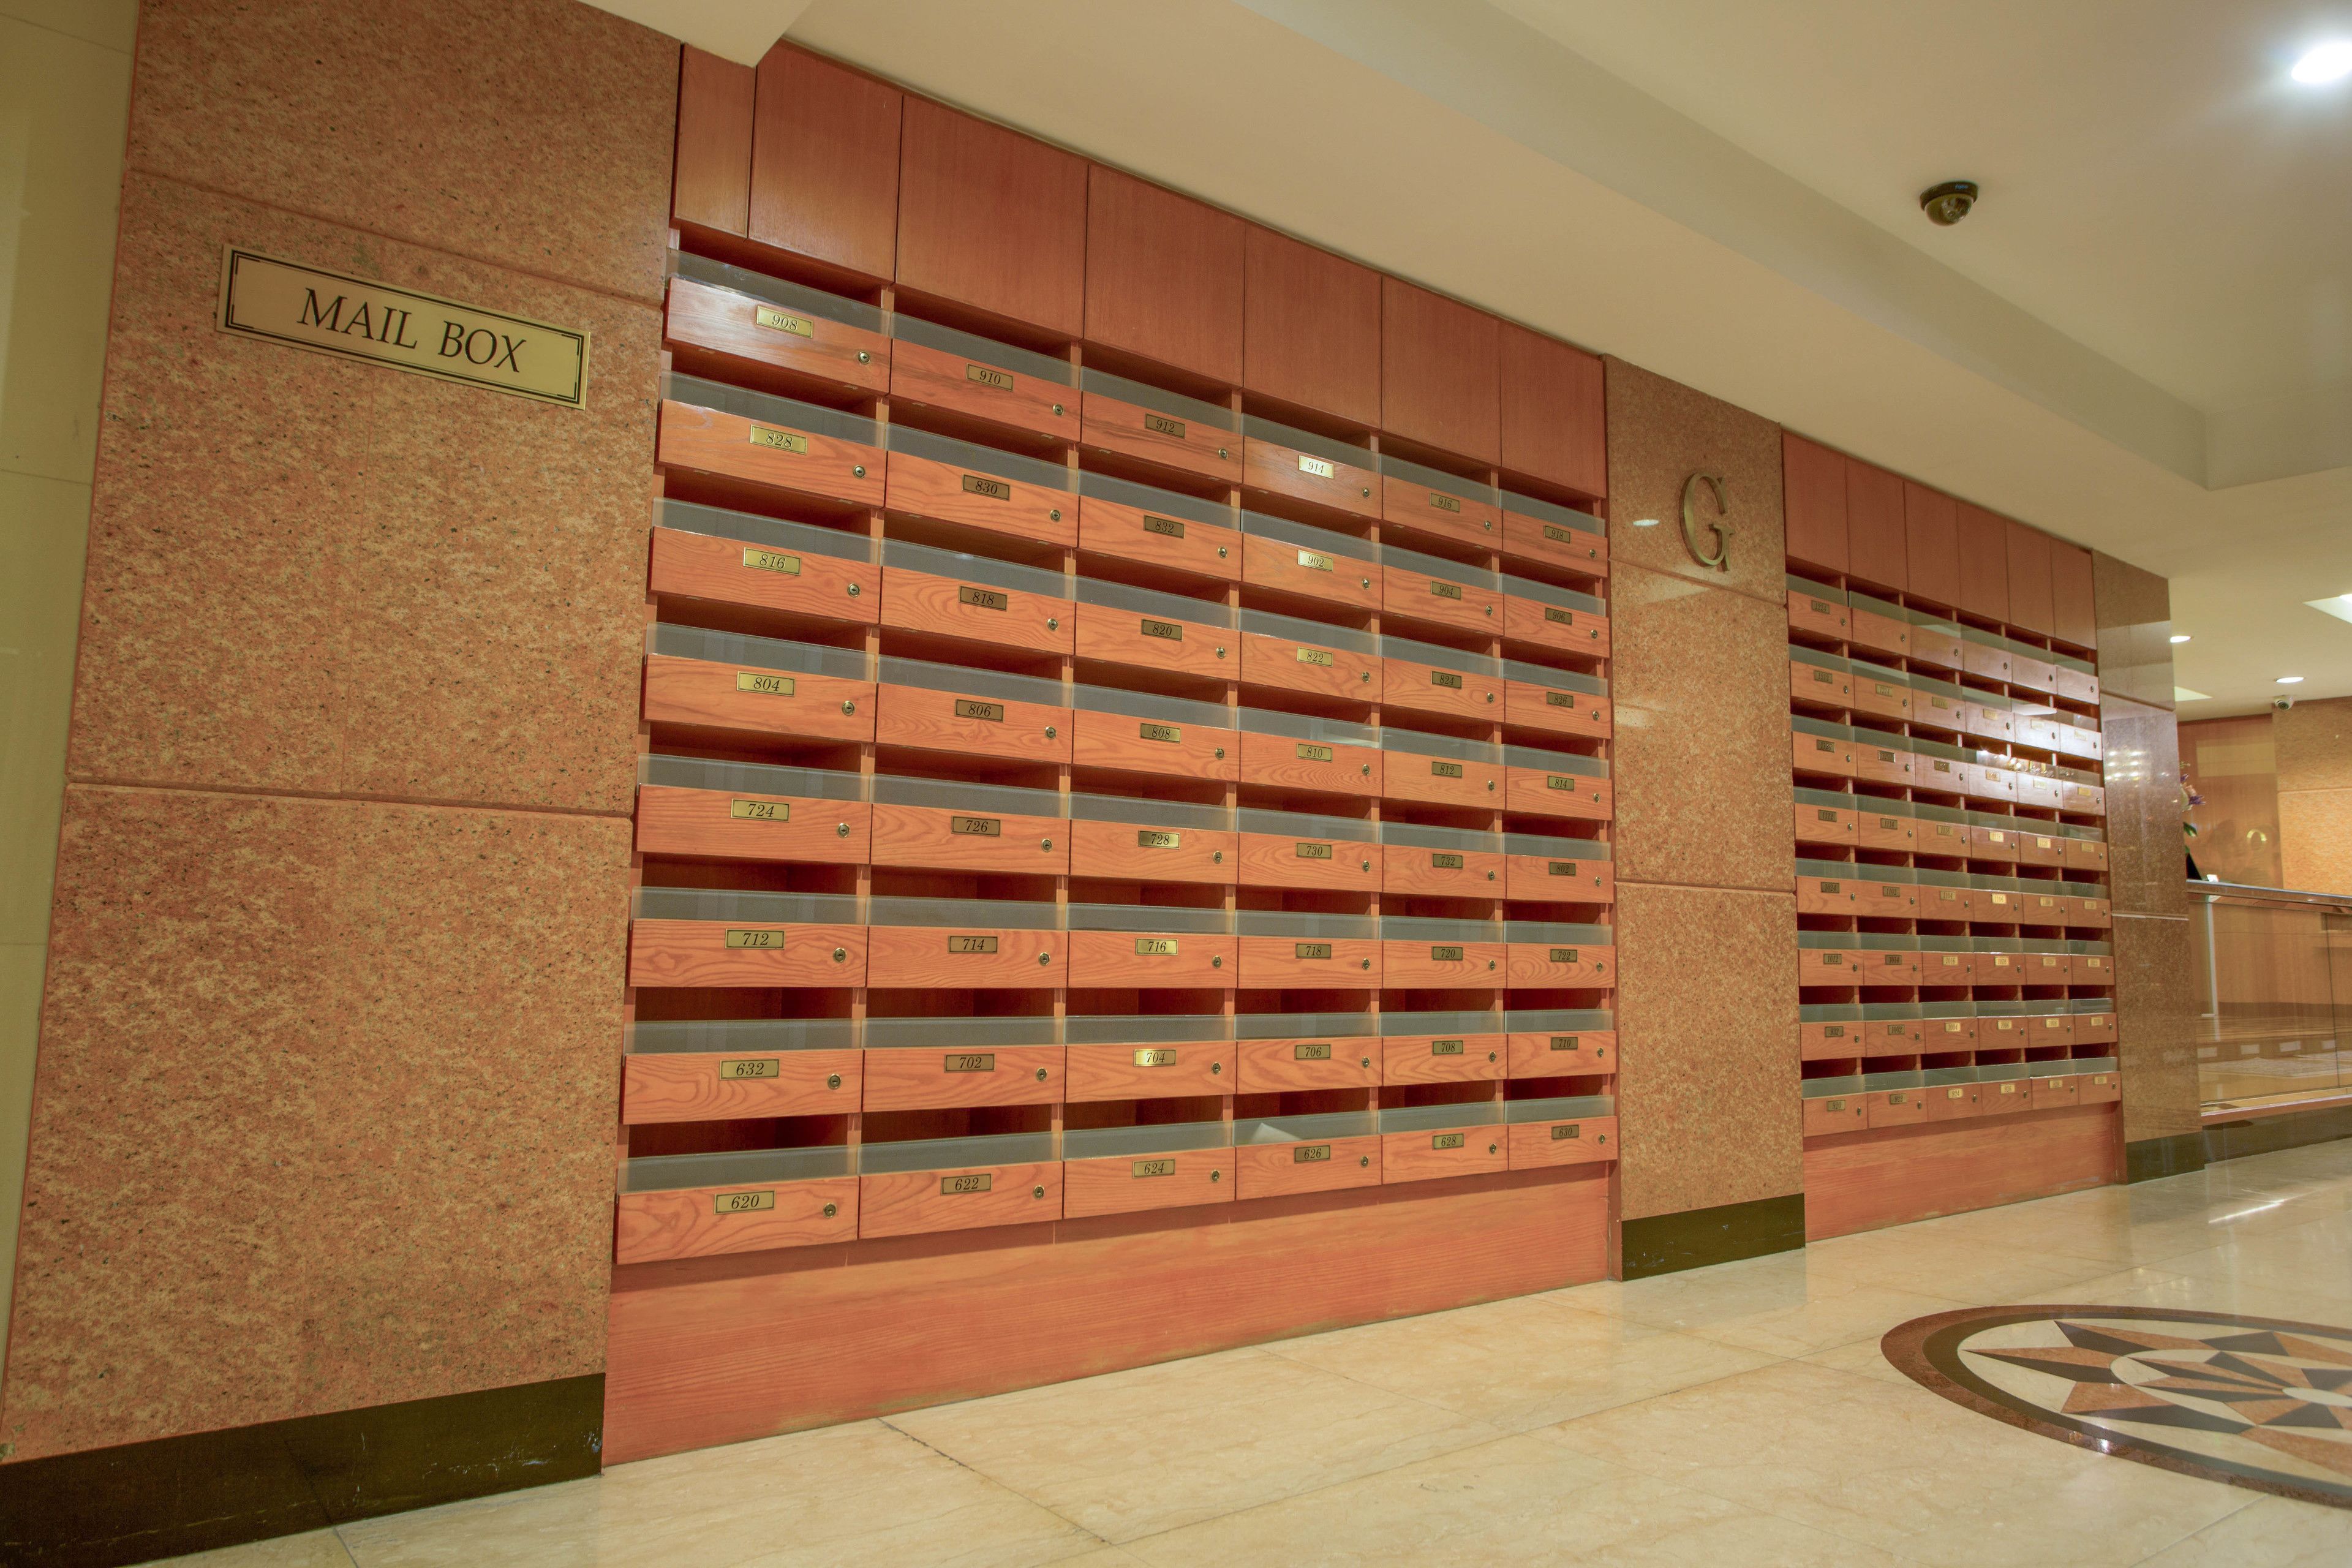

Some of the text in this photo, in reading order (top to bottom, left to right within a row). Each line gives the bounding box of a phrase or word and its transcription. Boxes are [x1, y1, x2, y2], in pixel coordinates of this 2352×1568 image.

[772, 314, 797, 331] 908
[296, 287, 527, 373] MAIL BOX
[979, 370, 1001, 385] 910
[1156, 421, 1175, 432] 912
[766, 434, 793, 448] 828
[1308, 462, 1324, 473] 914
[976, 482, 998, 494] 830
[1438, 499, 1452, 508] 916
[1156, 521, 1174, 533] 832
[1679, 472, 1735, 572] G
[1551, 530, 1564, 539] 918
[760, 556, 785, 569] 816
[1308, 556, 1324, 567] 902
[1439, 587, 1453, 595] 904
[973, 593, 993, 605] 818
[1553, 612, 1566, 621] 906
[1153, 624, 1172, 635] 820
[1307, 653, 1324, 663] 822
[753, 679, 780, 691] 804
[1439, 676, 1453, 685] 824
[968, 706, 991, 717] 806
[1152, 728, 1170, 739] 808
[1307, 748, 1323, 758] 810
[1440, 765, 1454, 774] 812
[1555, 779, 1567, 788] 814
[748, 804, 774, 817] 724
[966, 821, 988, 832] 726
[1151, 834, 1169, 845] 728
[1307, 846, 1323, 856] 730
[743, 933, 769, 946] 712
[963, 940, 984, 950] 714
[1148, 941, 1166, 952] 716
[1306, 946, 1322, 956] 718
[1305, 1047, 1322, 1057] 706
[1441, 1043, 1455, 1052] 708
[959, 1057, 982, 1069] 702
[1147, 1052, 1164, 1063] 704
[736, 1063, 764, 1076] 632
[1441, 1137, 1456, 1146] 628
[1304, 1149, 1321, 1159] 626
[1144, 1163, 1163, 1173] 624
[955, 1178, 979, 1190] 622
[731, 1195, 760, 1208] 620
